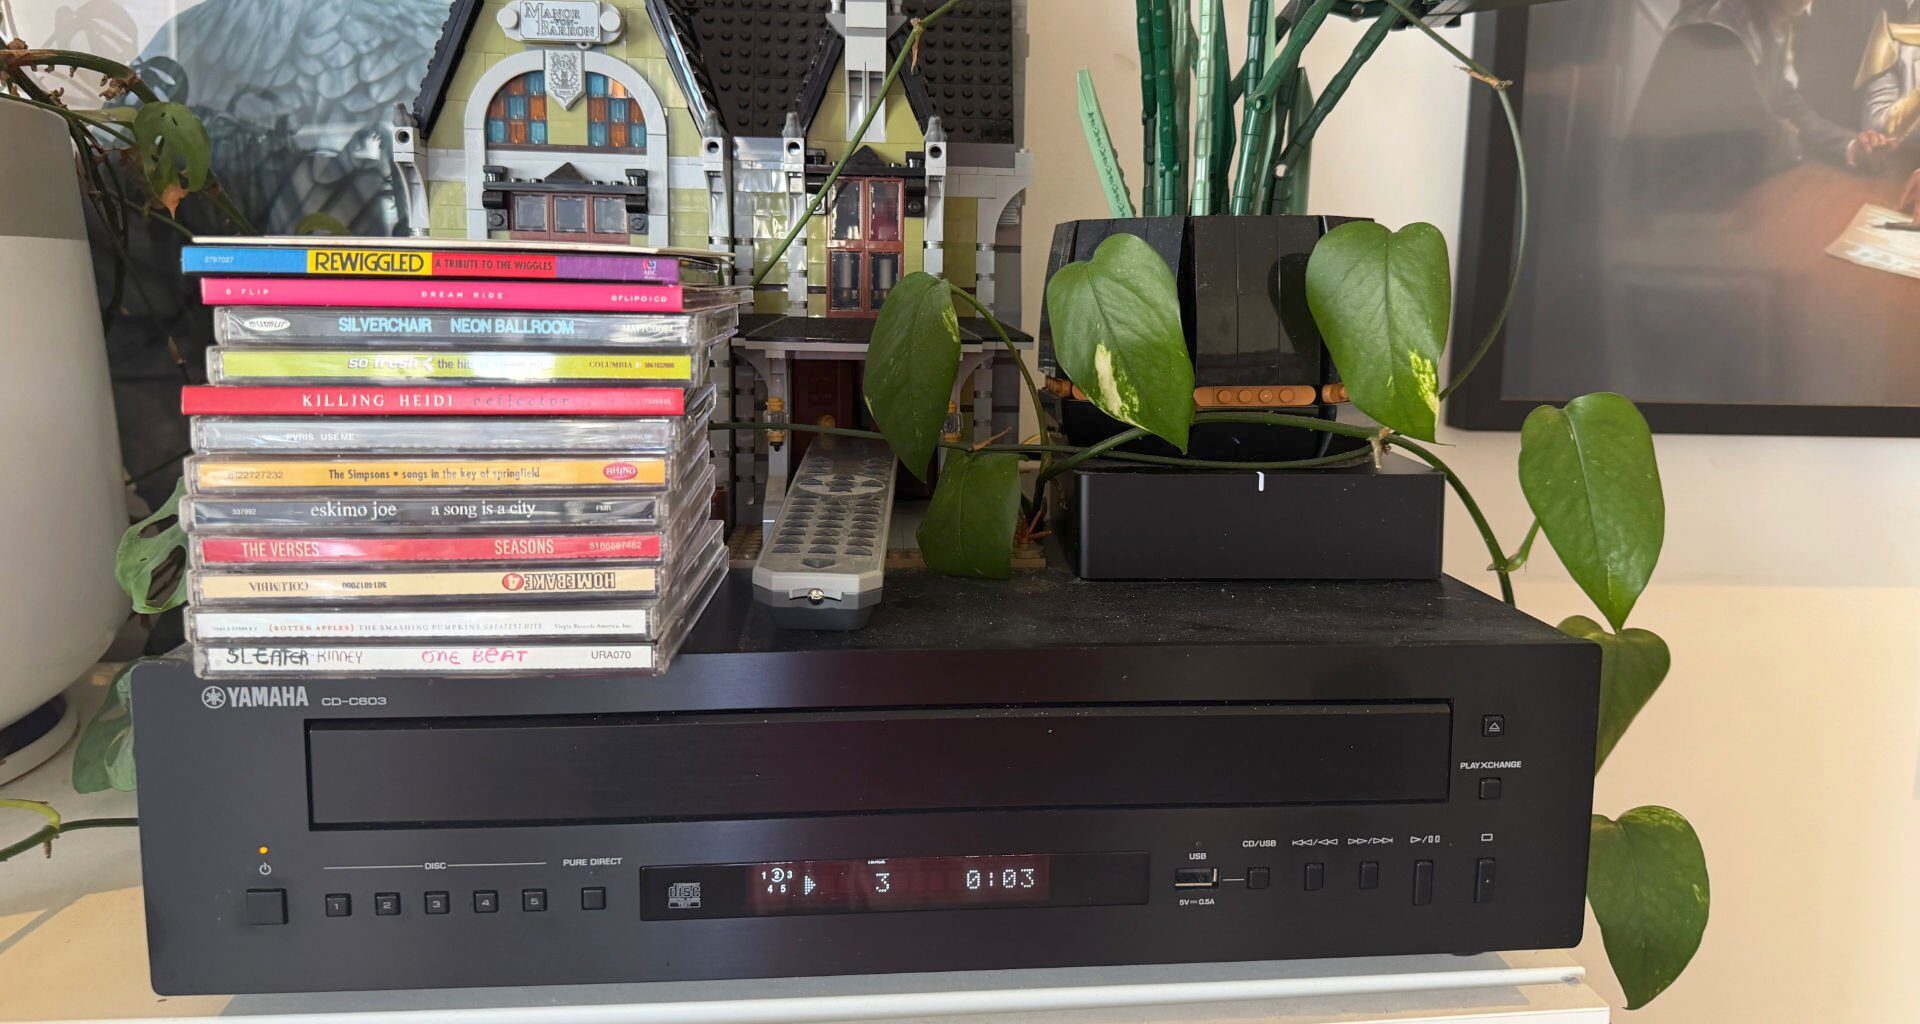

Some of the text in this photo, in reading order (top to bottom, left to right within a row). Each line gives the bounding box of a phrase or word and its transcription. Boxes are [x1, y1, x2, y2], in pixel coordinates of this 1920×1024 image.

[524, 2, 581, 20] MANOR
[536, 20, 595, 37] BARRON
[315, 252, 424, 272] REWIGGLED
[436, 259, 552, 271] A TRIBUTE TO THE WIGGLES
[421, 290, 504, 300] DREAM RIDE
[338, 317, 432, 332] SILVERCHAIR
[451, 319, 574, 335] NEON BALLROOM
[348, 355, 418, 369] so fresh
[438, 359, 454, 368] the
[303, 394, 453, 407] KILLING HEIDI
[474, 394, 570, 406] reflector
[329, 467, 539, 481] The Simpsons songs in the key of springfield
[606, 466, 636, 476] RHINO
[310, 501, 397, 520] eskimo joe
[431, 500, 536, 518] a song is a city
[242, 542, 319, 557] THE VERSES
[495, 540, 554, 555] SEASONS
[250, 582, 308, 591] COLUMBIA
[524, 572, 615, 590] HOMEBAKE
[591, 651, 631, 659] URA070
[227, 686, 387, 707] YAMAHA CD-C603
[1460, 761, 1522, 769] PLAYXCHANGE
[1242, 839, 1276, 847] CD/USB
[425, 862, 446, 870] DISC
[762, 871, 766, 880] 1
[774, 871, 780, 879] 2
[876, 873, 889, 892] 3
[967, 868, 1034, 889] 0:03
[768, 885, 772, 893] 4
